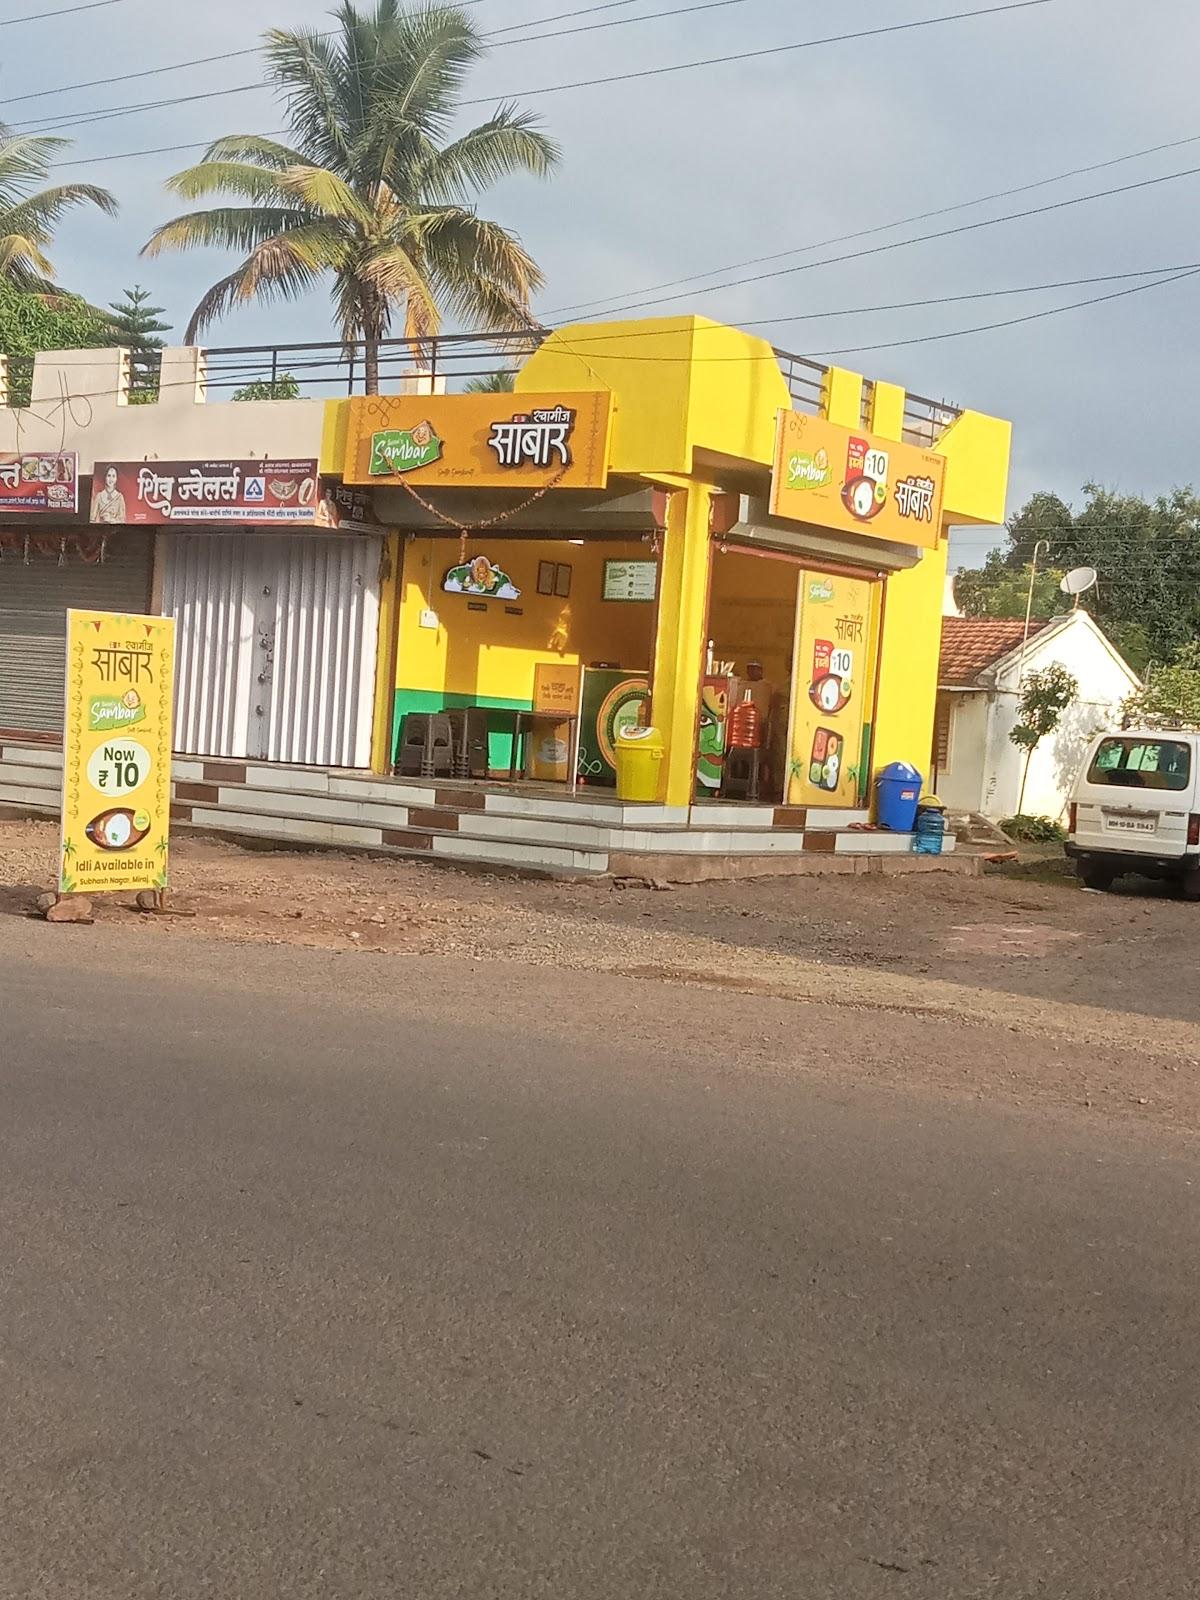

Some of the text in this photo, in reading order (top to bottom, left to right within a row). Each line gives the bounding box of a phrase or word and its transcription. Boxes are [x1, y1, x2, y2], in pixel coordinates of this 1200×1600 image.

[374, 439, 430, 466] Sambar
[789, 456, 825, 482] Sambar
[137, 467, 175, 517] शिव
[91, 701, 139, 724] Sambar
[103, 747, 135, 761] Now
[114, 762, 139, 787] 10
[75, 858, 155, 872] Idli Available in
[80, 877, 109, 886] Subhash
